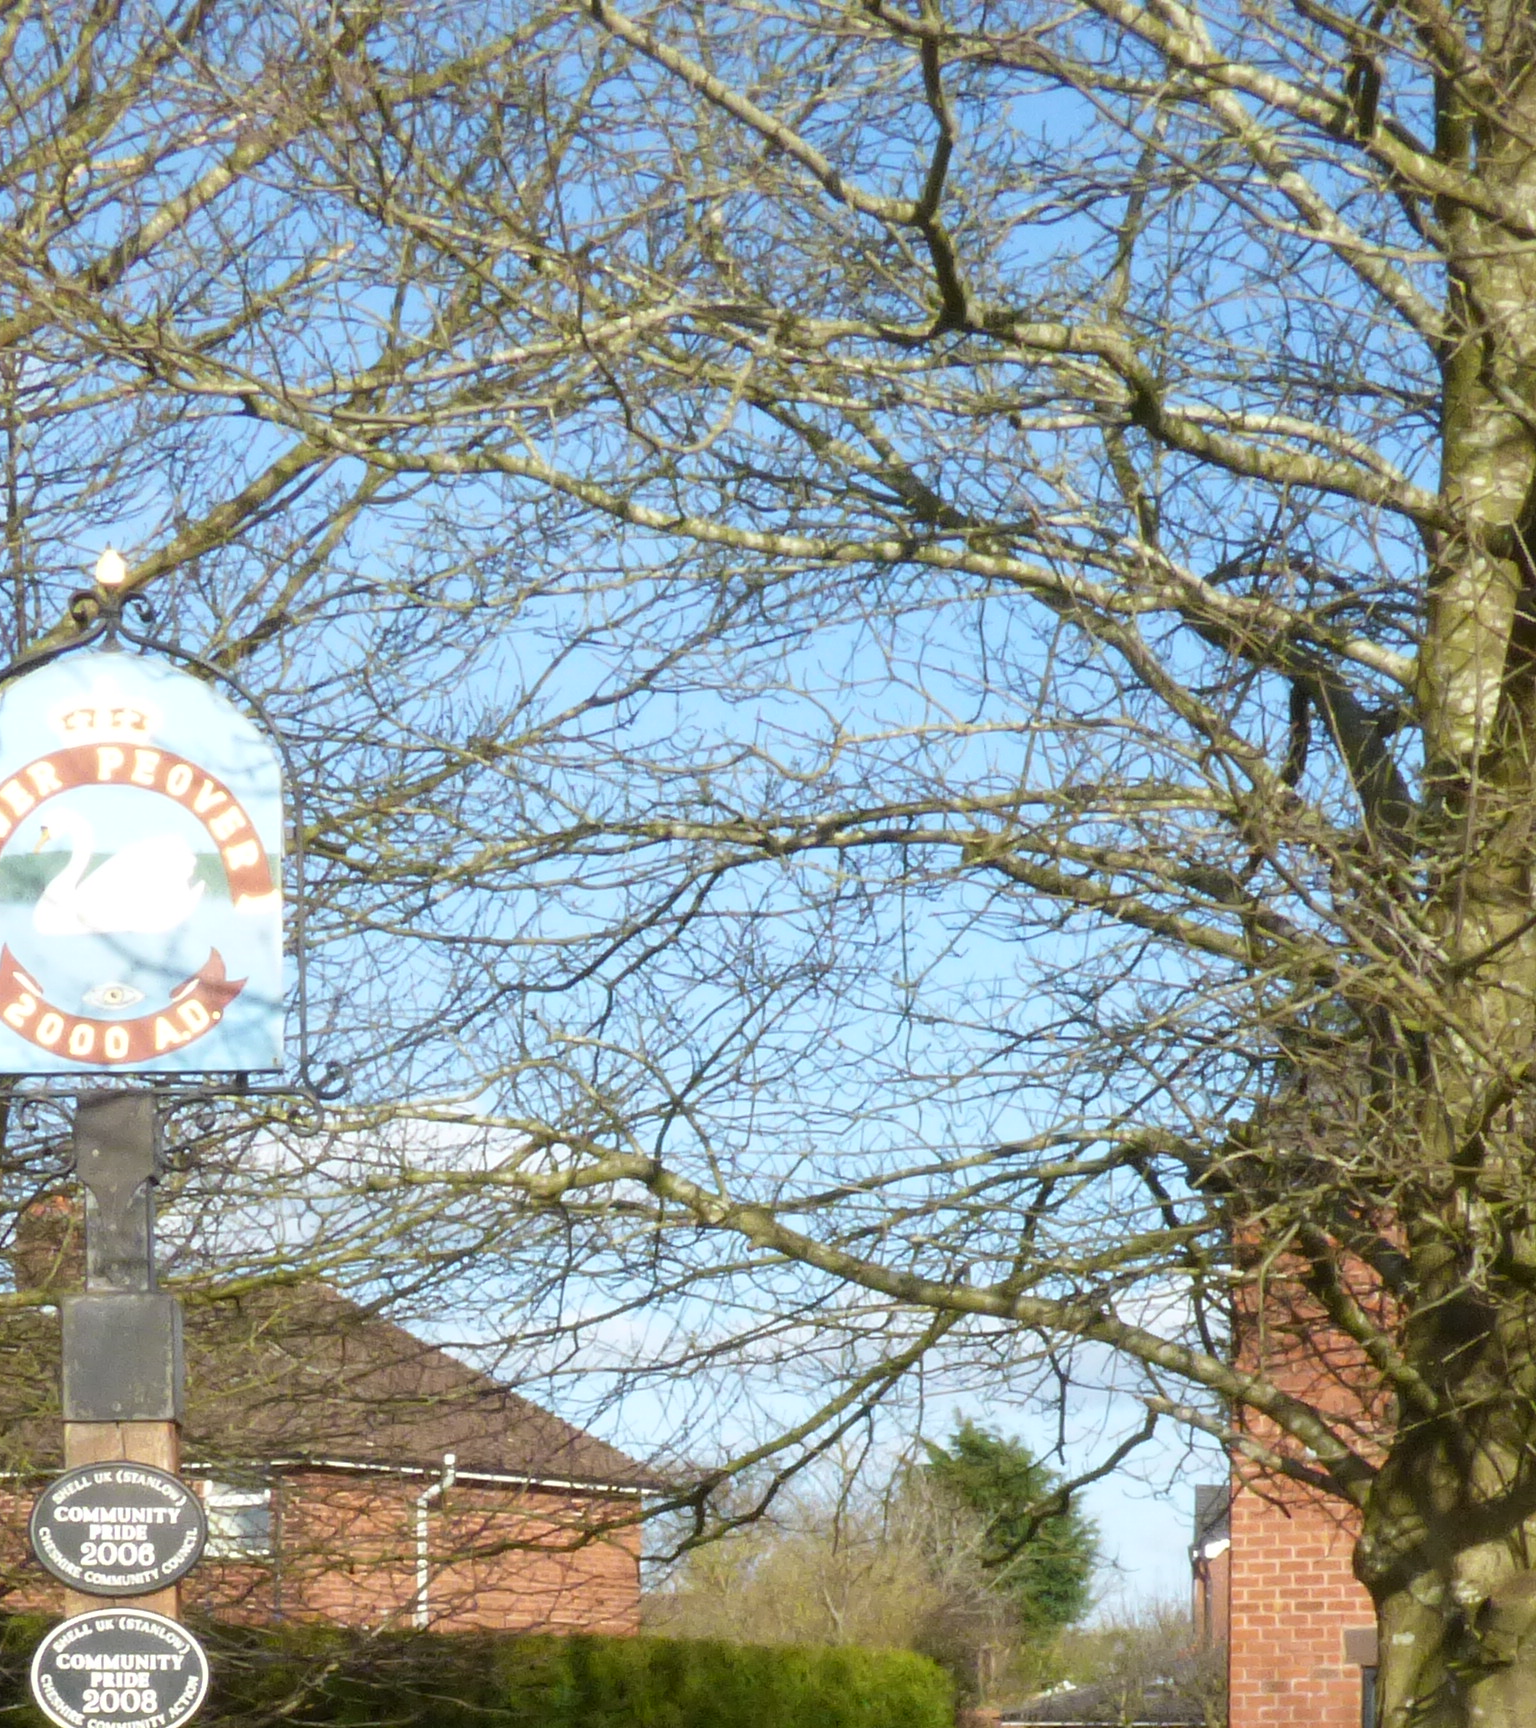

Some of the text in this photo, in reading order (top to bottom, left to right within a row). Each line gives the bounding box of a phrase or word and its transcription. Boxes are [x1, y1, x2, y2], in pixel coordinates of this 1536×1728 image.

[96, 746, 259, 871] PEOVER
[3, 993, 222, 1060] 2000 A.D.
[51, 1469, 187, 1507] SHELL UK (STANLOW)
[53, 1505, 182, 1524] COMMUNITY
[89, 1524, 148, 1541] PRIDE
[38, 1527, 198, 1587] CHESHIRE COMMUNITY COUNCIL
[79, 1541, 156, 1567] 2006
[52, 1616, 192, 1655] SHELL UK (STANLOW)
[55, 1653, 185, 1671] COMMUNITY
[90, 1671, 151, 1688] PRIDE
[40, 1673, 86, 1726] CHESHIRE
[168, 1675, 200, 1718] ACTION
[82, 1688, 158, 1714] 2008
